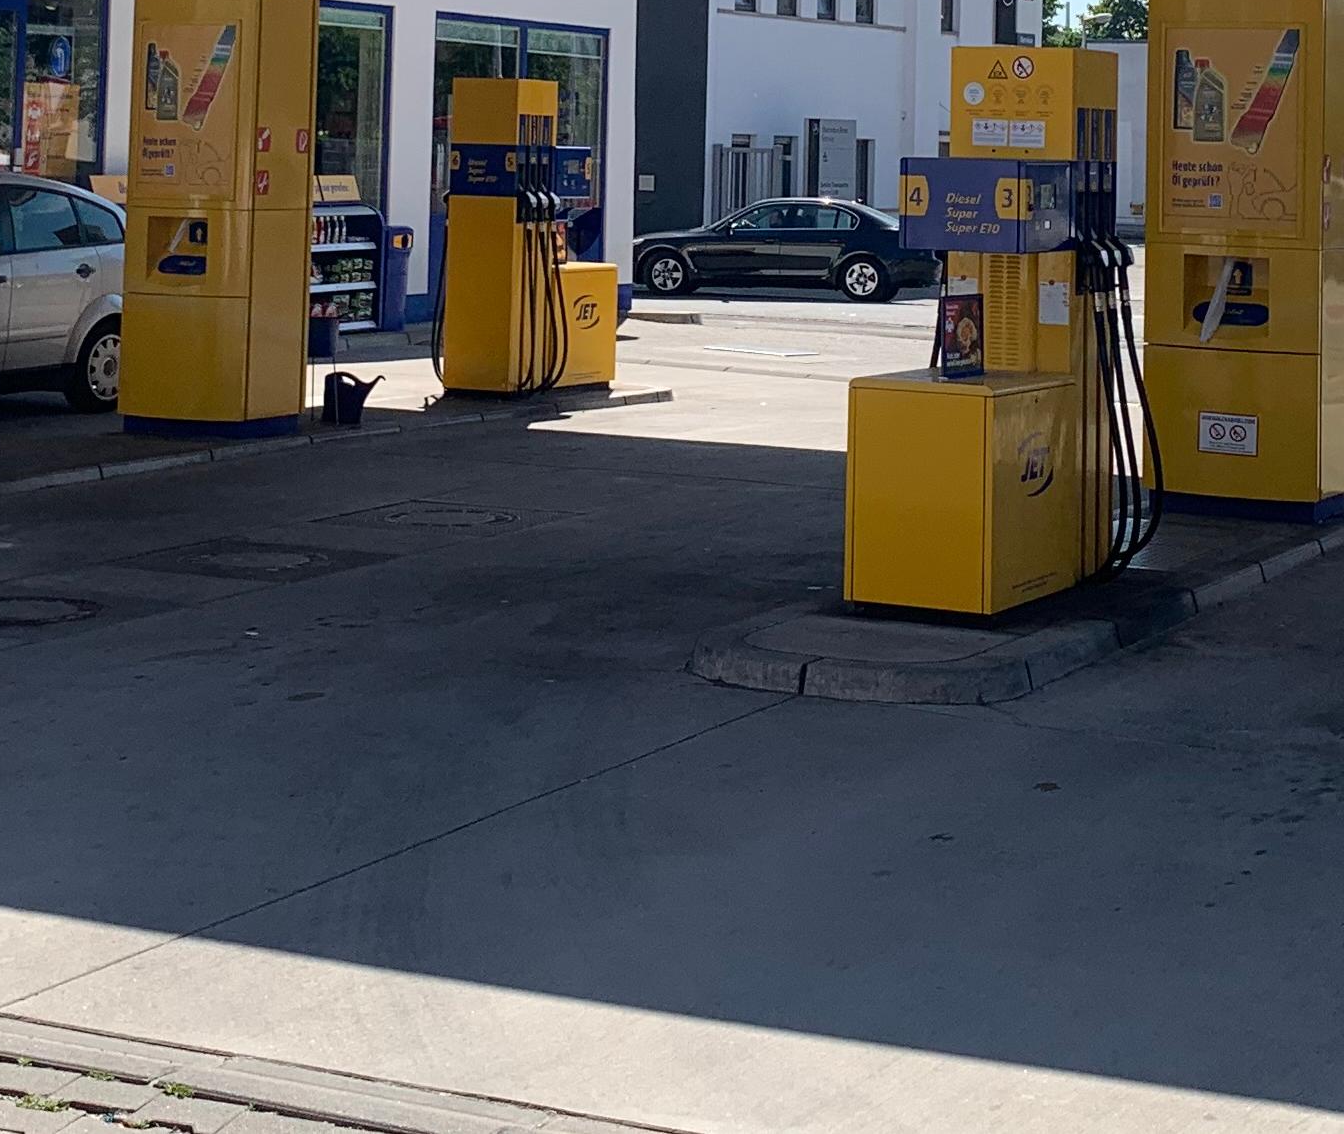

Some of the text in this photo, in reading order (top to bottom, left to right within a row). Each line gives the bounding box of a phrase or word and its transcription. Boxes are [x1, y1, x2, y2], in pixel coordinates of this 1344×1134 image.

[1172, 160, 1223, 172] Heute schon
[908, 187, 923, 207] 4
[945, 192, 982, 205] Diesel
[1001, 188, 1013, 208] 3
[945, 207, 978, 221] Super
[944, 221, 1001, 236] Super E10
[575, 302, 598, 322] JET
[1020, 447, 1050, 483] JET
